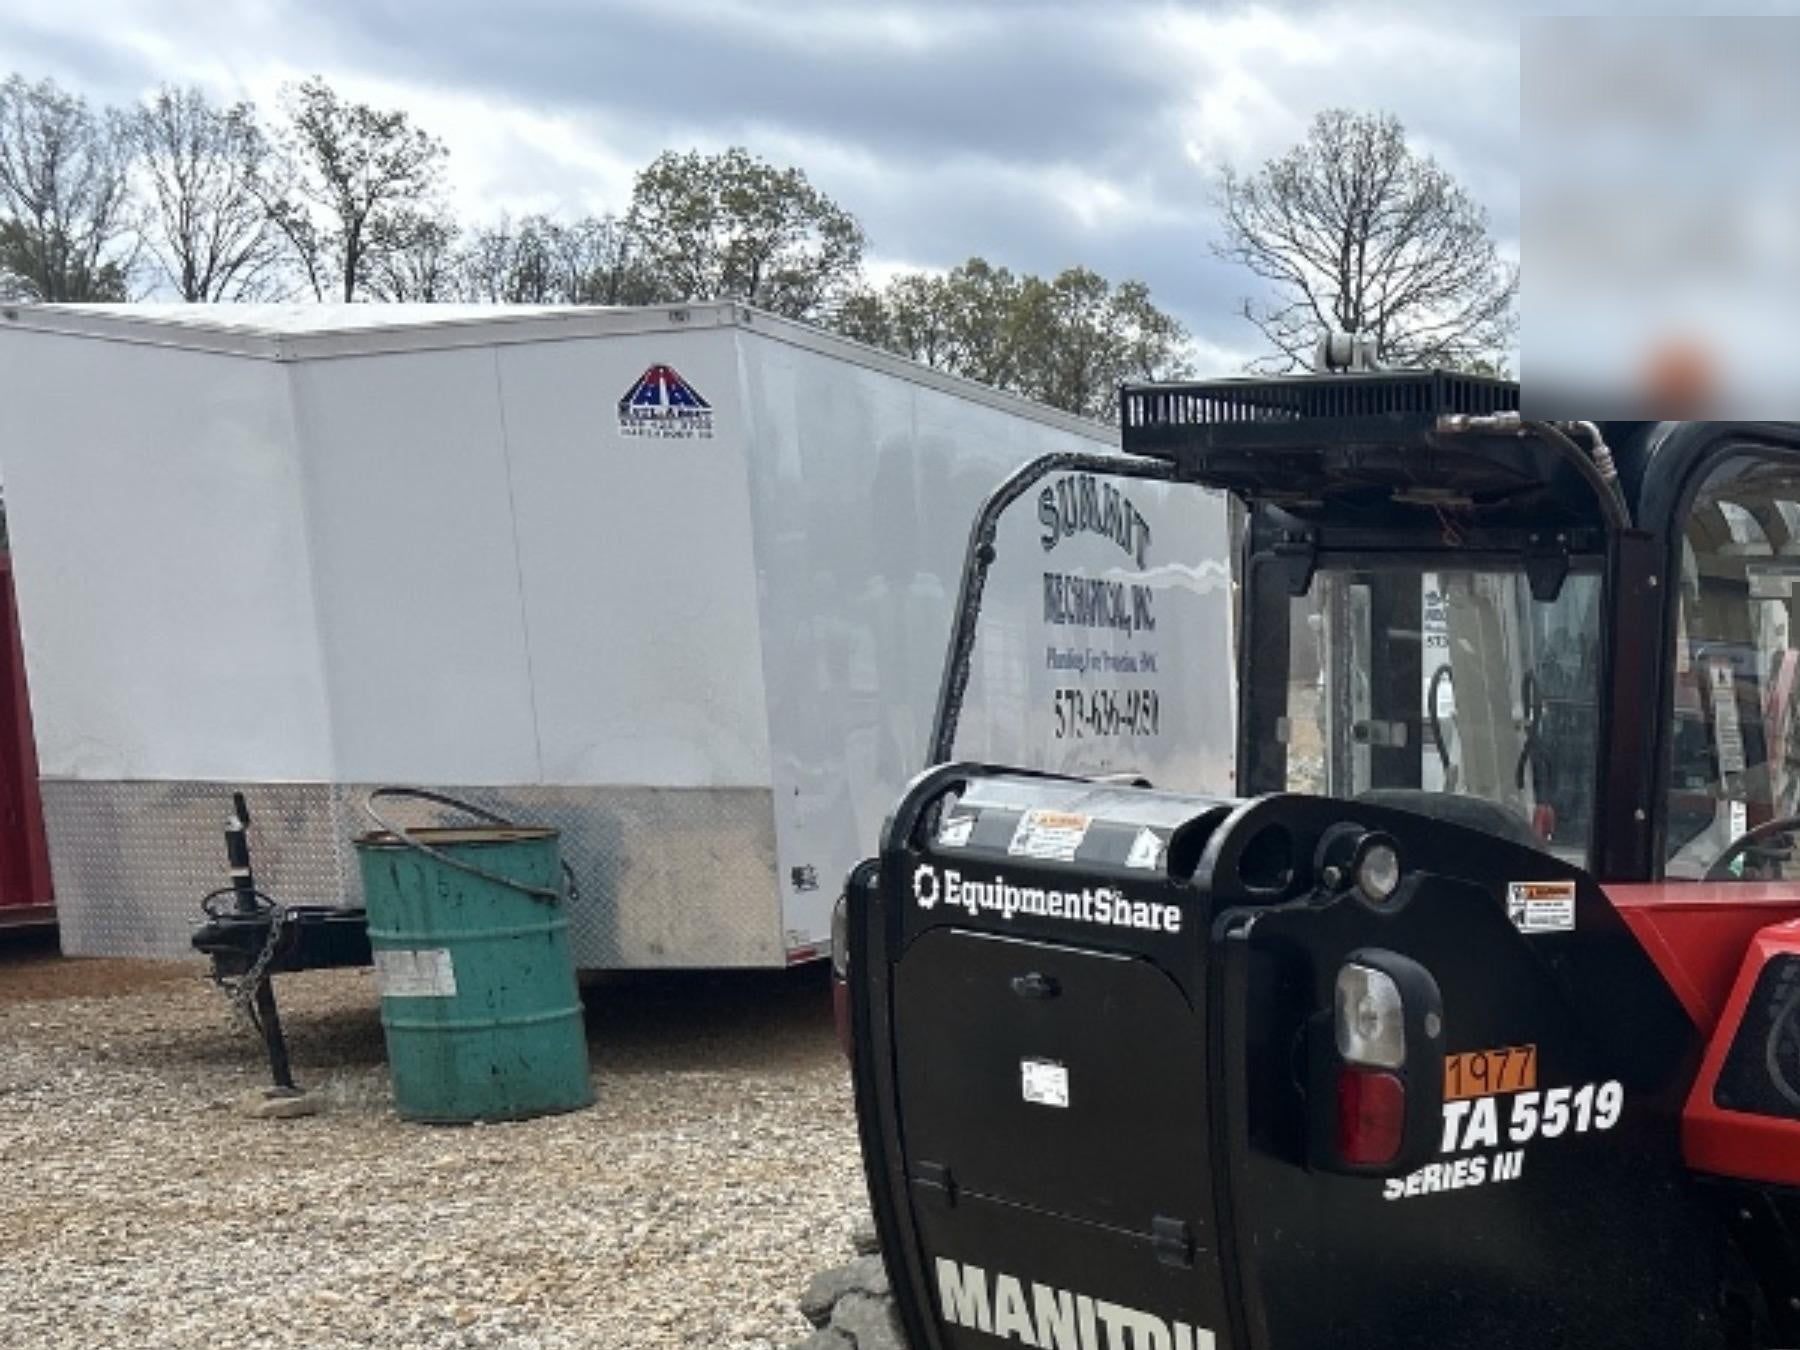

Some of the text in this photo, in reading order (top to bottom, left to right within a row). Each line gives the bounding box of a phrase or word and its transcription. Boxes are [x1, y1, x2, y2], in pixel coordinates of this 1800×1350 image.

[1037, 473, 1151, 571] SUMMIT
[944, 868, 1181, 933] EquipmentShare
[1448, 1050, 1533, 1095] 1977
[1441, 1079, 1625, 1152] TA 5519
[1382, 1150, 1525, 1200] SERIES III
